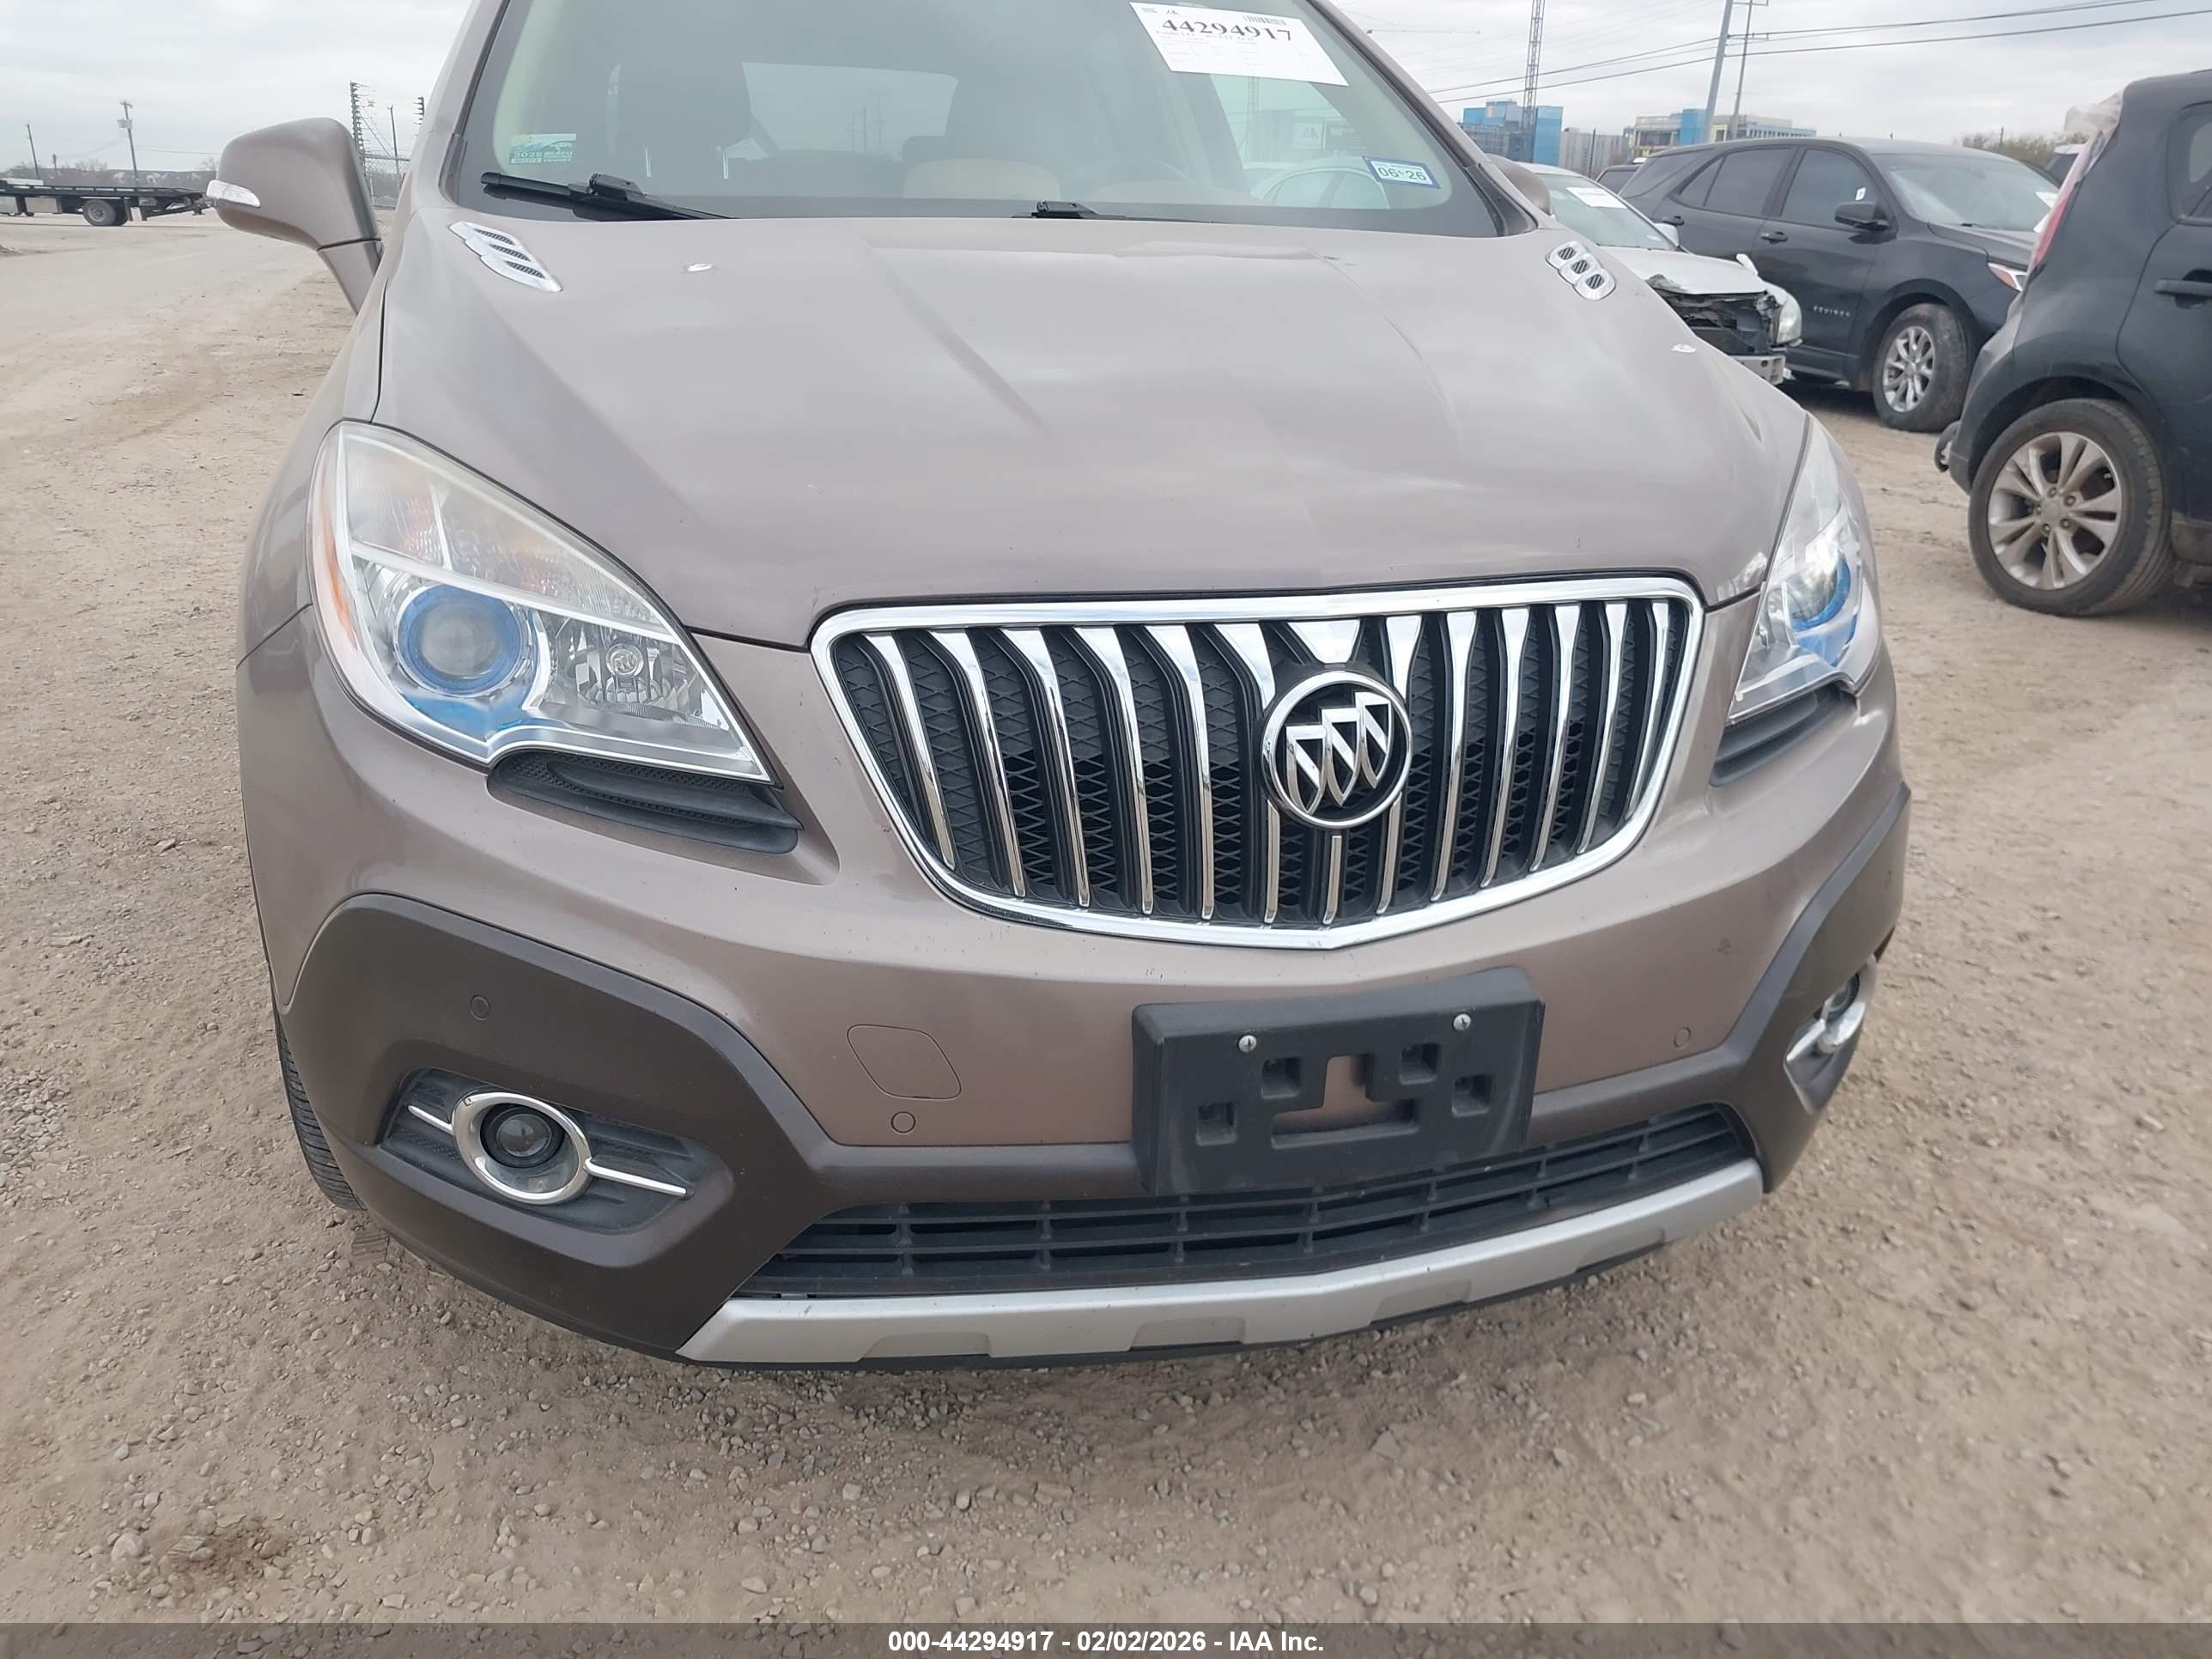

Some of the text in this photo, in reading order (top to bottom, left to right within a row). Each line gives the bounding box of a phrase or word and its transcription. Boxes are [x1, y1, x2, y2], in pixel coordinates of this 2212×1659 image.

[1162, 19, 1292, 41] 44294917
[1377, 167, 1400, 178] 06
[1405, 170, 1427, 181] 26
